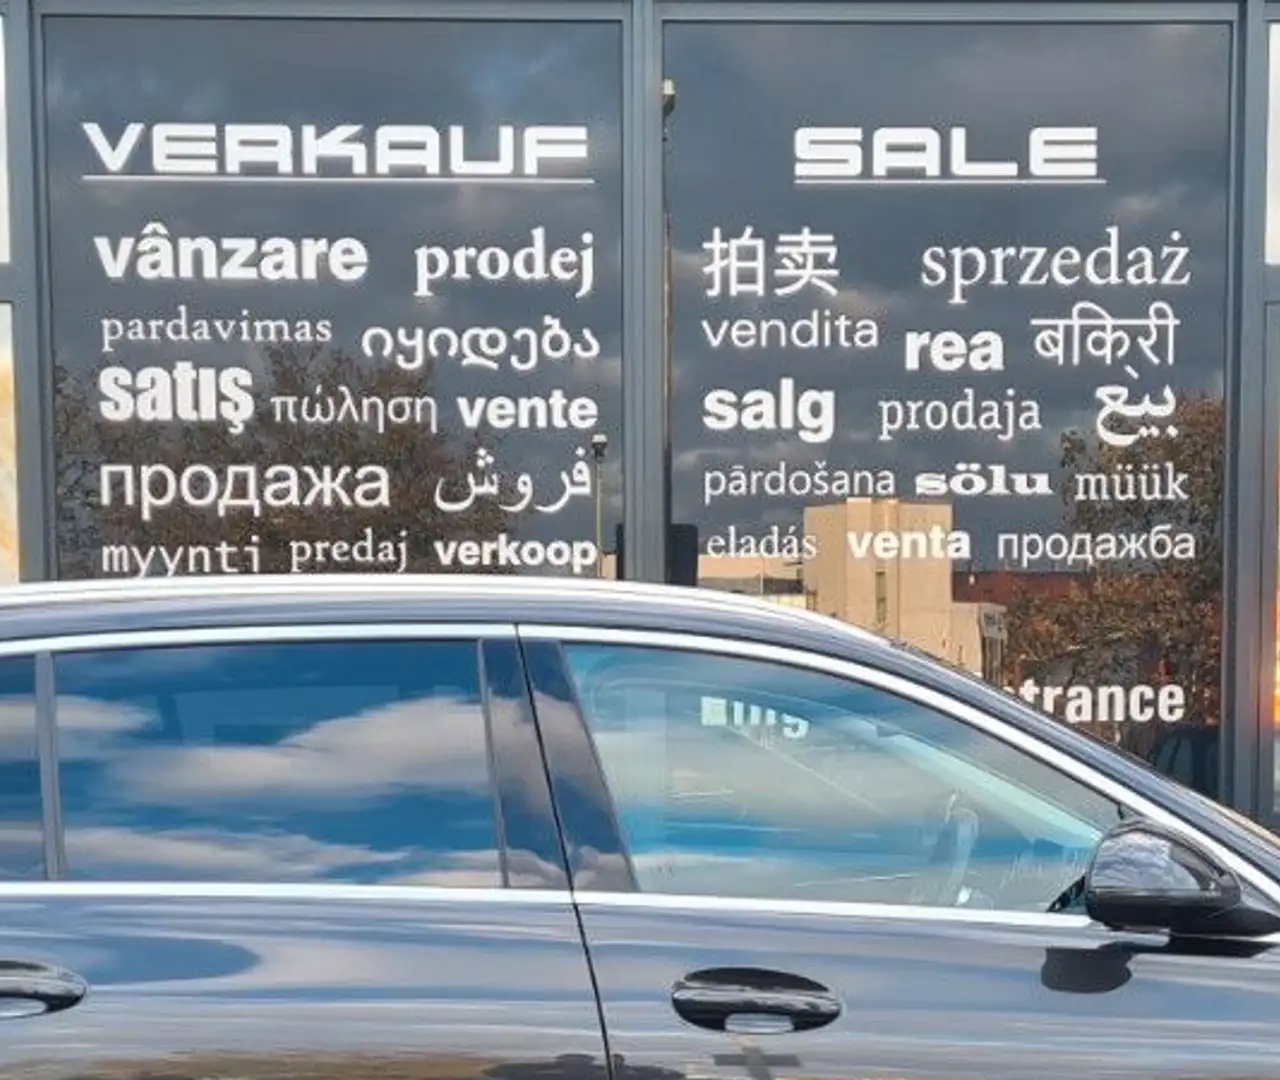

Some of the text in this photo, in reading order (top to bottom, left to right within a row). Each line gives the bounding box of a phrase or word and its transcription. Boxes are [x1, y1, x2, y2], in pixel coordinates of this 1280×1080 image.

[82, 122, 589, 174] VERKAUF
[794, 127, 1098, 176] SALE
[93, 222, 594, 298] vânzare prodej
[702, 226, 840, 297] 拍卖
[921, 225, 1191, 303] sprzedaż
[101, 304, 332, 352] pardavimas
[361, 315, 600, 370] იყიდება
[701, 309, 1004, 371] vendita rea
[99, 361, 255, 434] satış
[270, 384, 437, 433] πώληση
[456, 389, 598, 429] vente
[702, 377, 1042, 443] salg prodaja
[1095, 384, 1179, 446] بيع
[100, 463, 390, 521] продажа
[703, 460, 1189, 504] pārdošana sölu müük
[102, 527, 598, 577] myynti predaj verkoop
[706, 523, 970, 560] eladás venta
[998, 522, 1196, 562] продажба
[1003, 678, 1185, 723] trance
